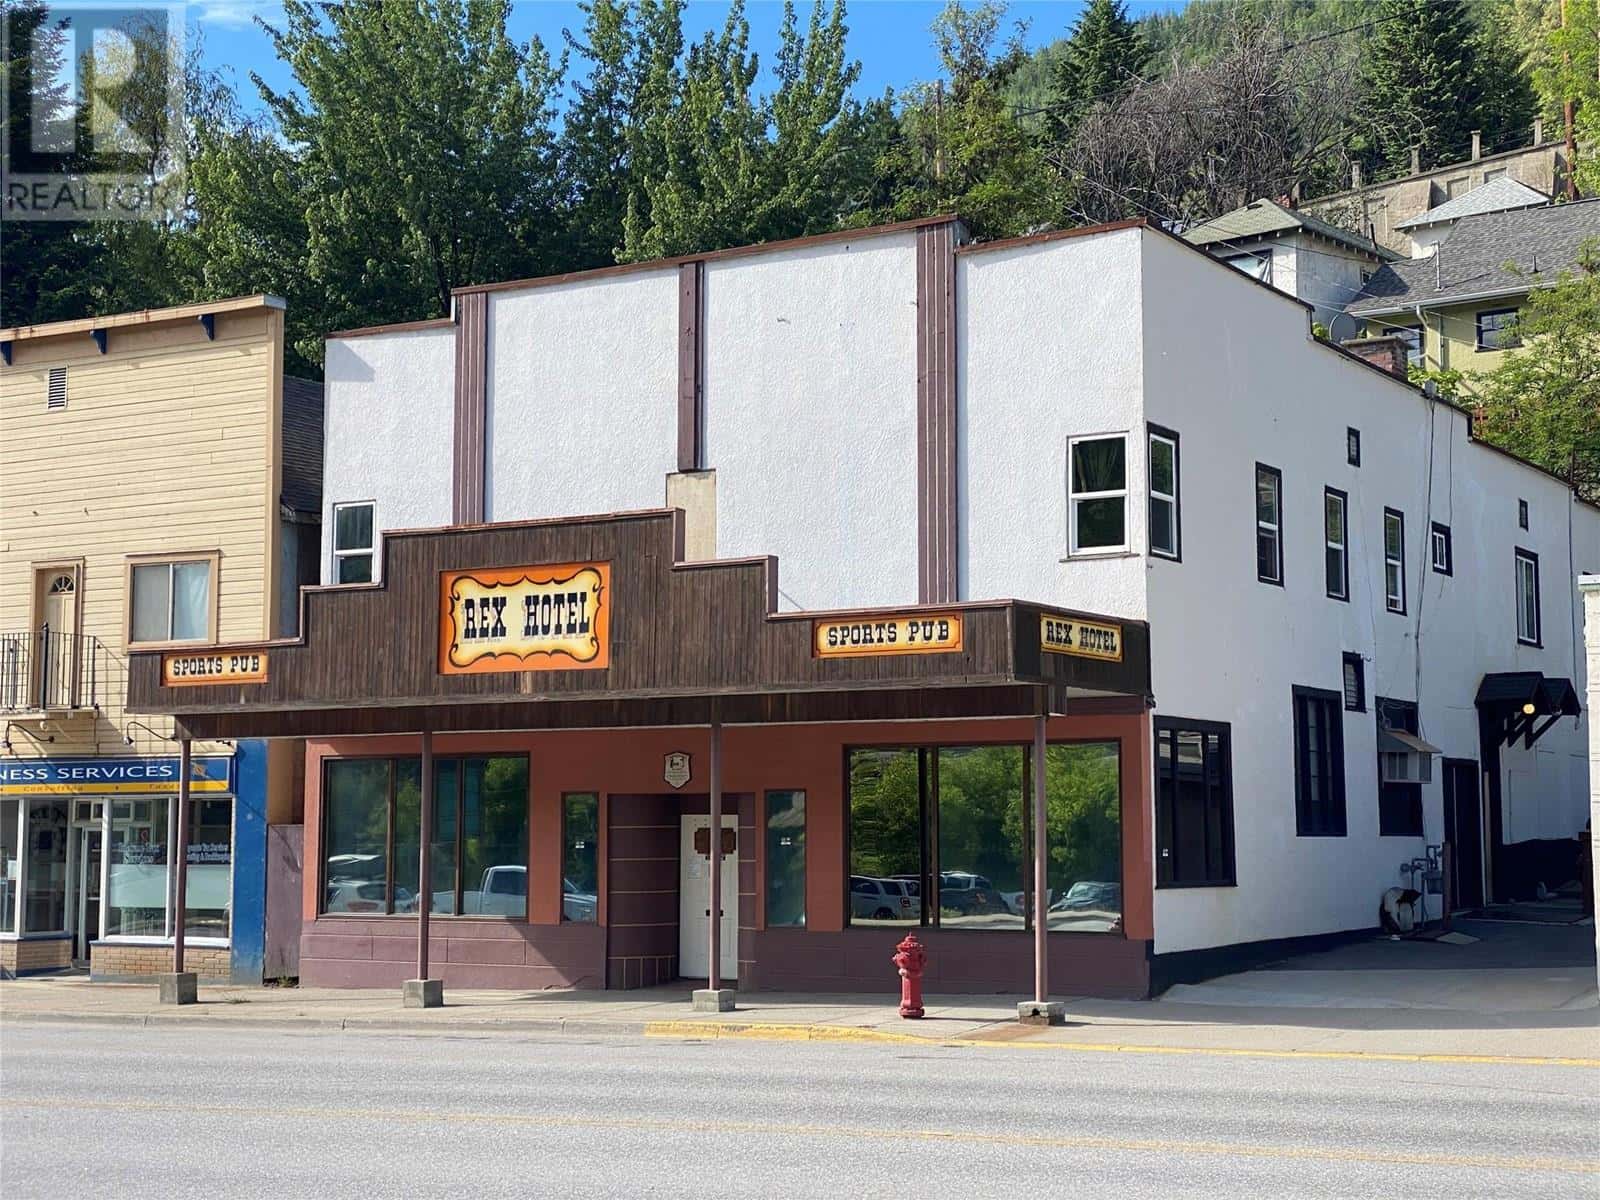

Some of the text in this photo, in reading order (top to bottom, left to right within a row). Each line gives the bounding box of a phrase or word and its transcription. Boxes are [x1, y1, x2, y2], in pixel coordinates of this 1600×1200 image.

[464, 592, 590, 638] REX HOTEL
[828, 620, 949, 645] SPORTS PUB
[1046, 620, 1118, 652] REX HOTEL
[173, 655, 260, 675] SPORTS PUB
[56, 765, 172, 778] SERVICES
